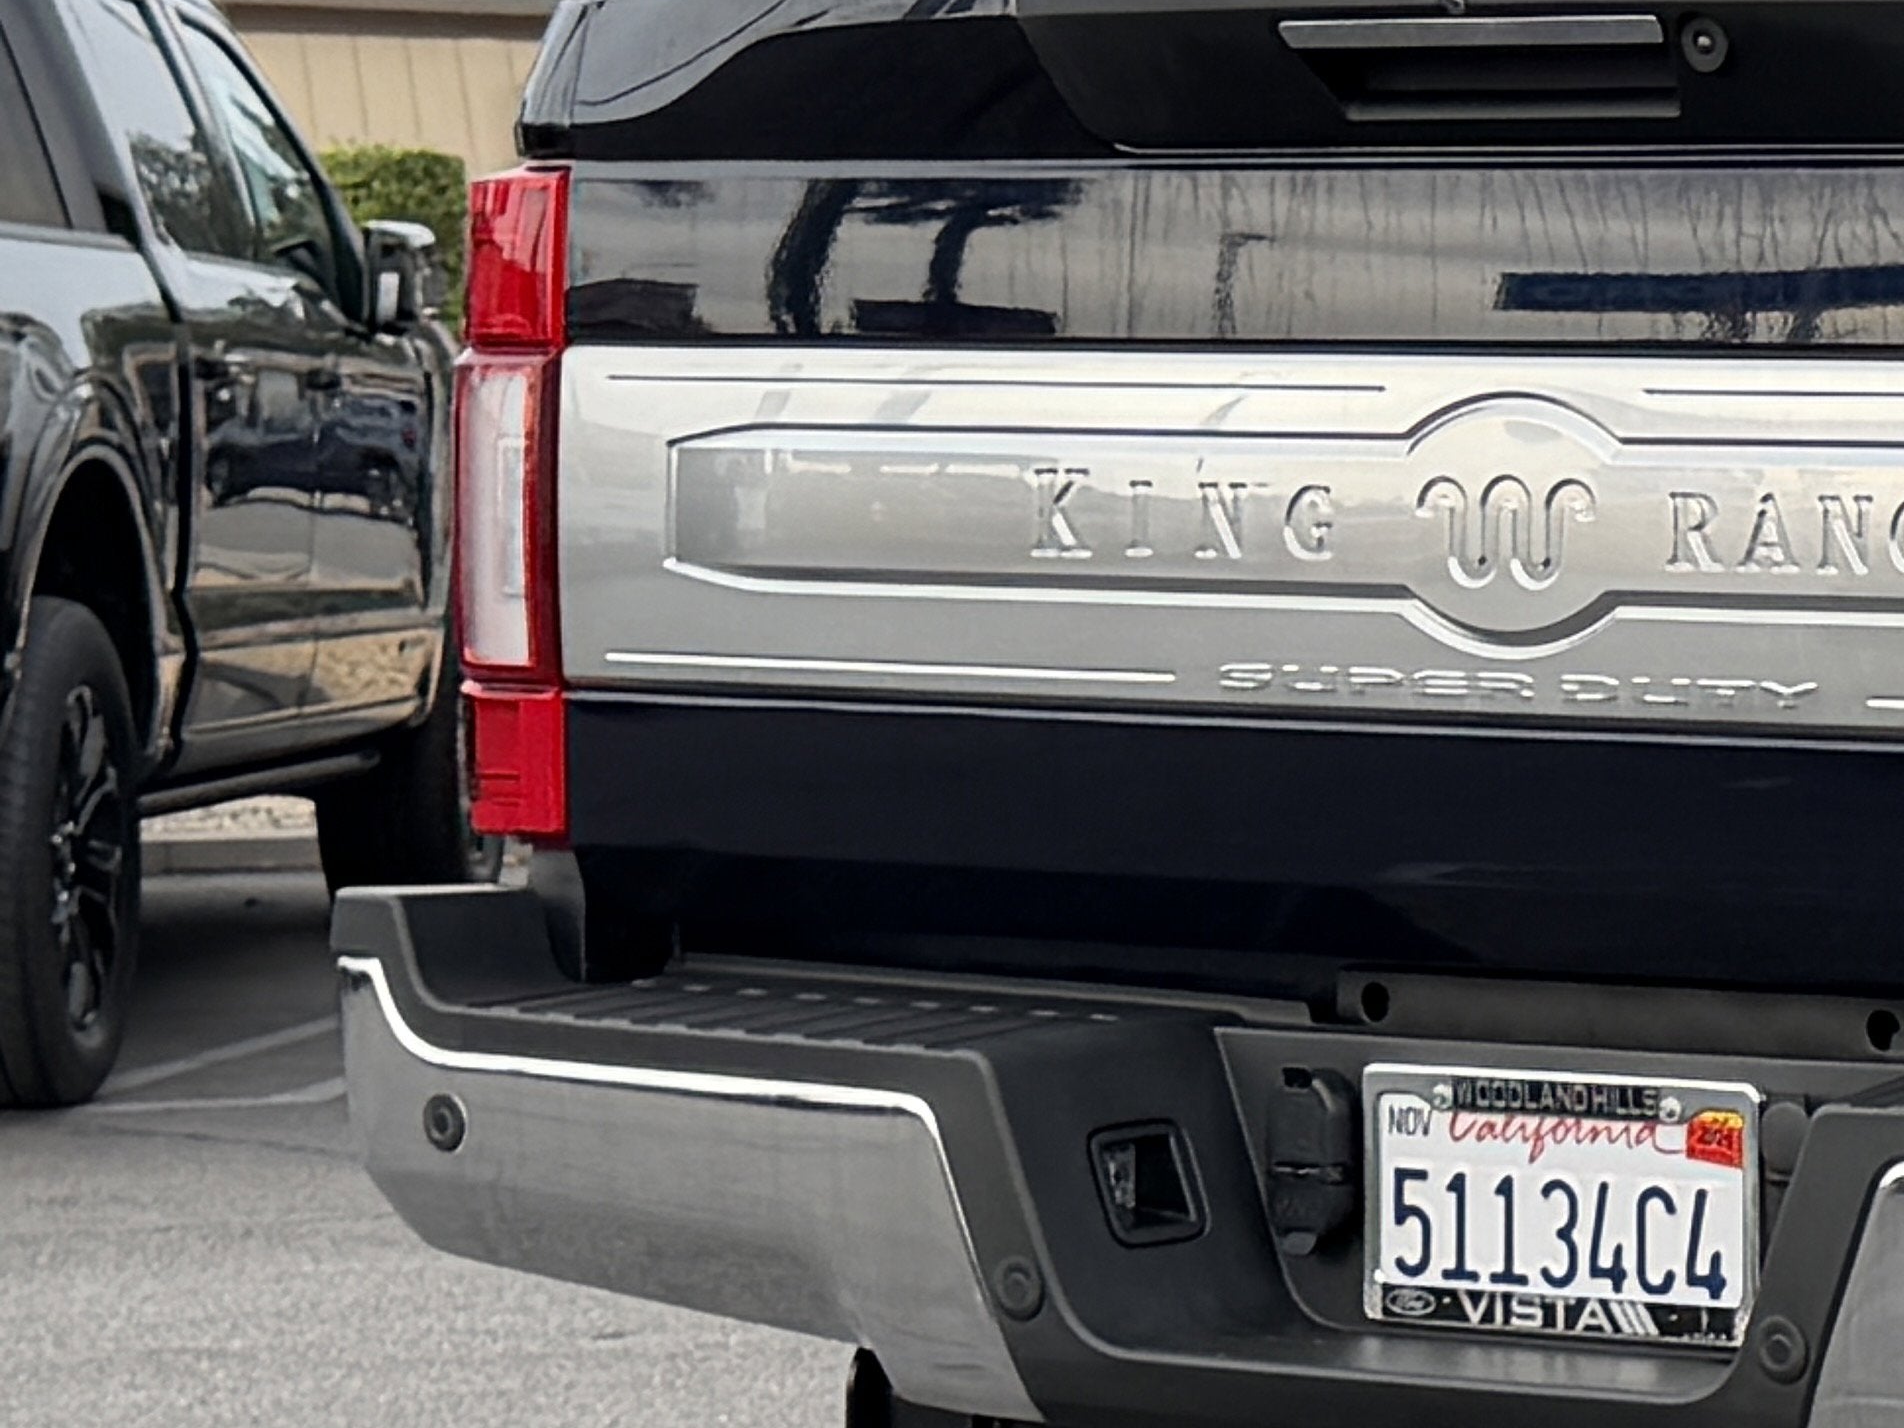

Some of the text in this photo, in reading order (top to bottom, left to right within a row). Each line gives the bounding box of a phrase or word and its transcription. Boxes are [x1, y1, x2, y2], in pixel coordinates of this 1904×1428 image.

[1030, 466, 1334, 561] KING
[1218, 662, 1819, 709] SUPER DUTY
[1388, 1104, 1432, 1137] NOV
[1450, 1110, 1686, 1164] California
[1394, 1166, 1727, 1300] 51134C4
[1458, 1289, 1614, 1335] VISTA
